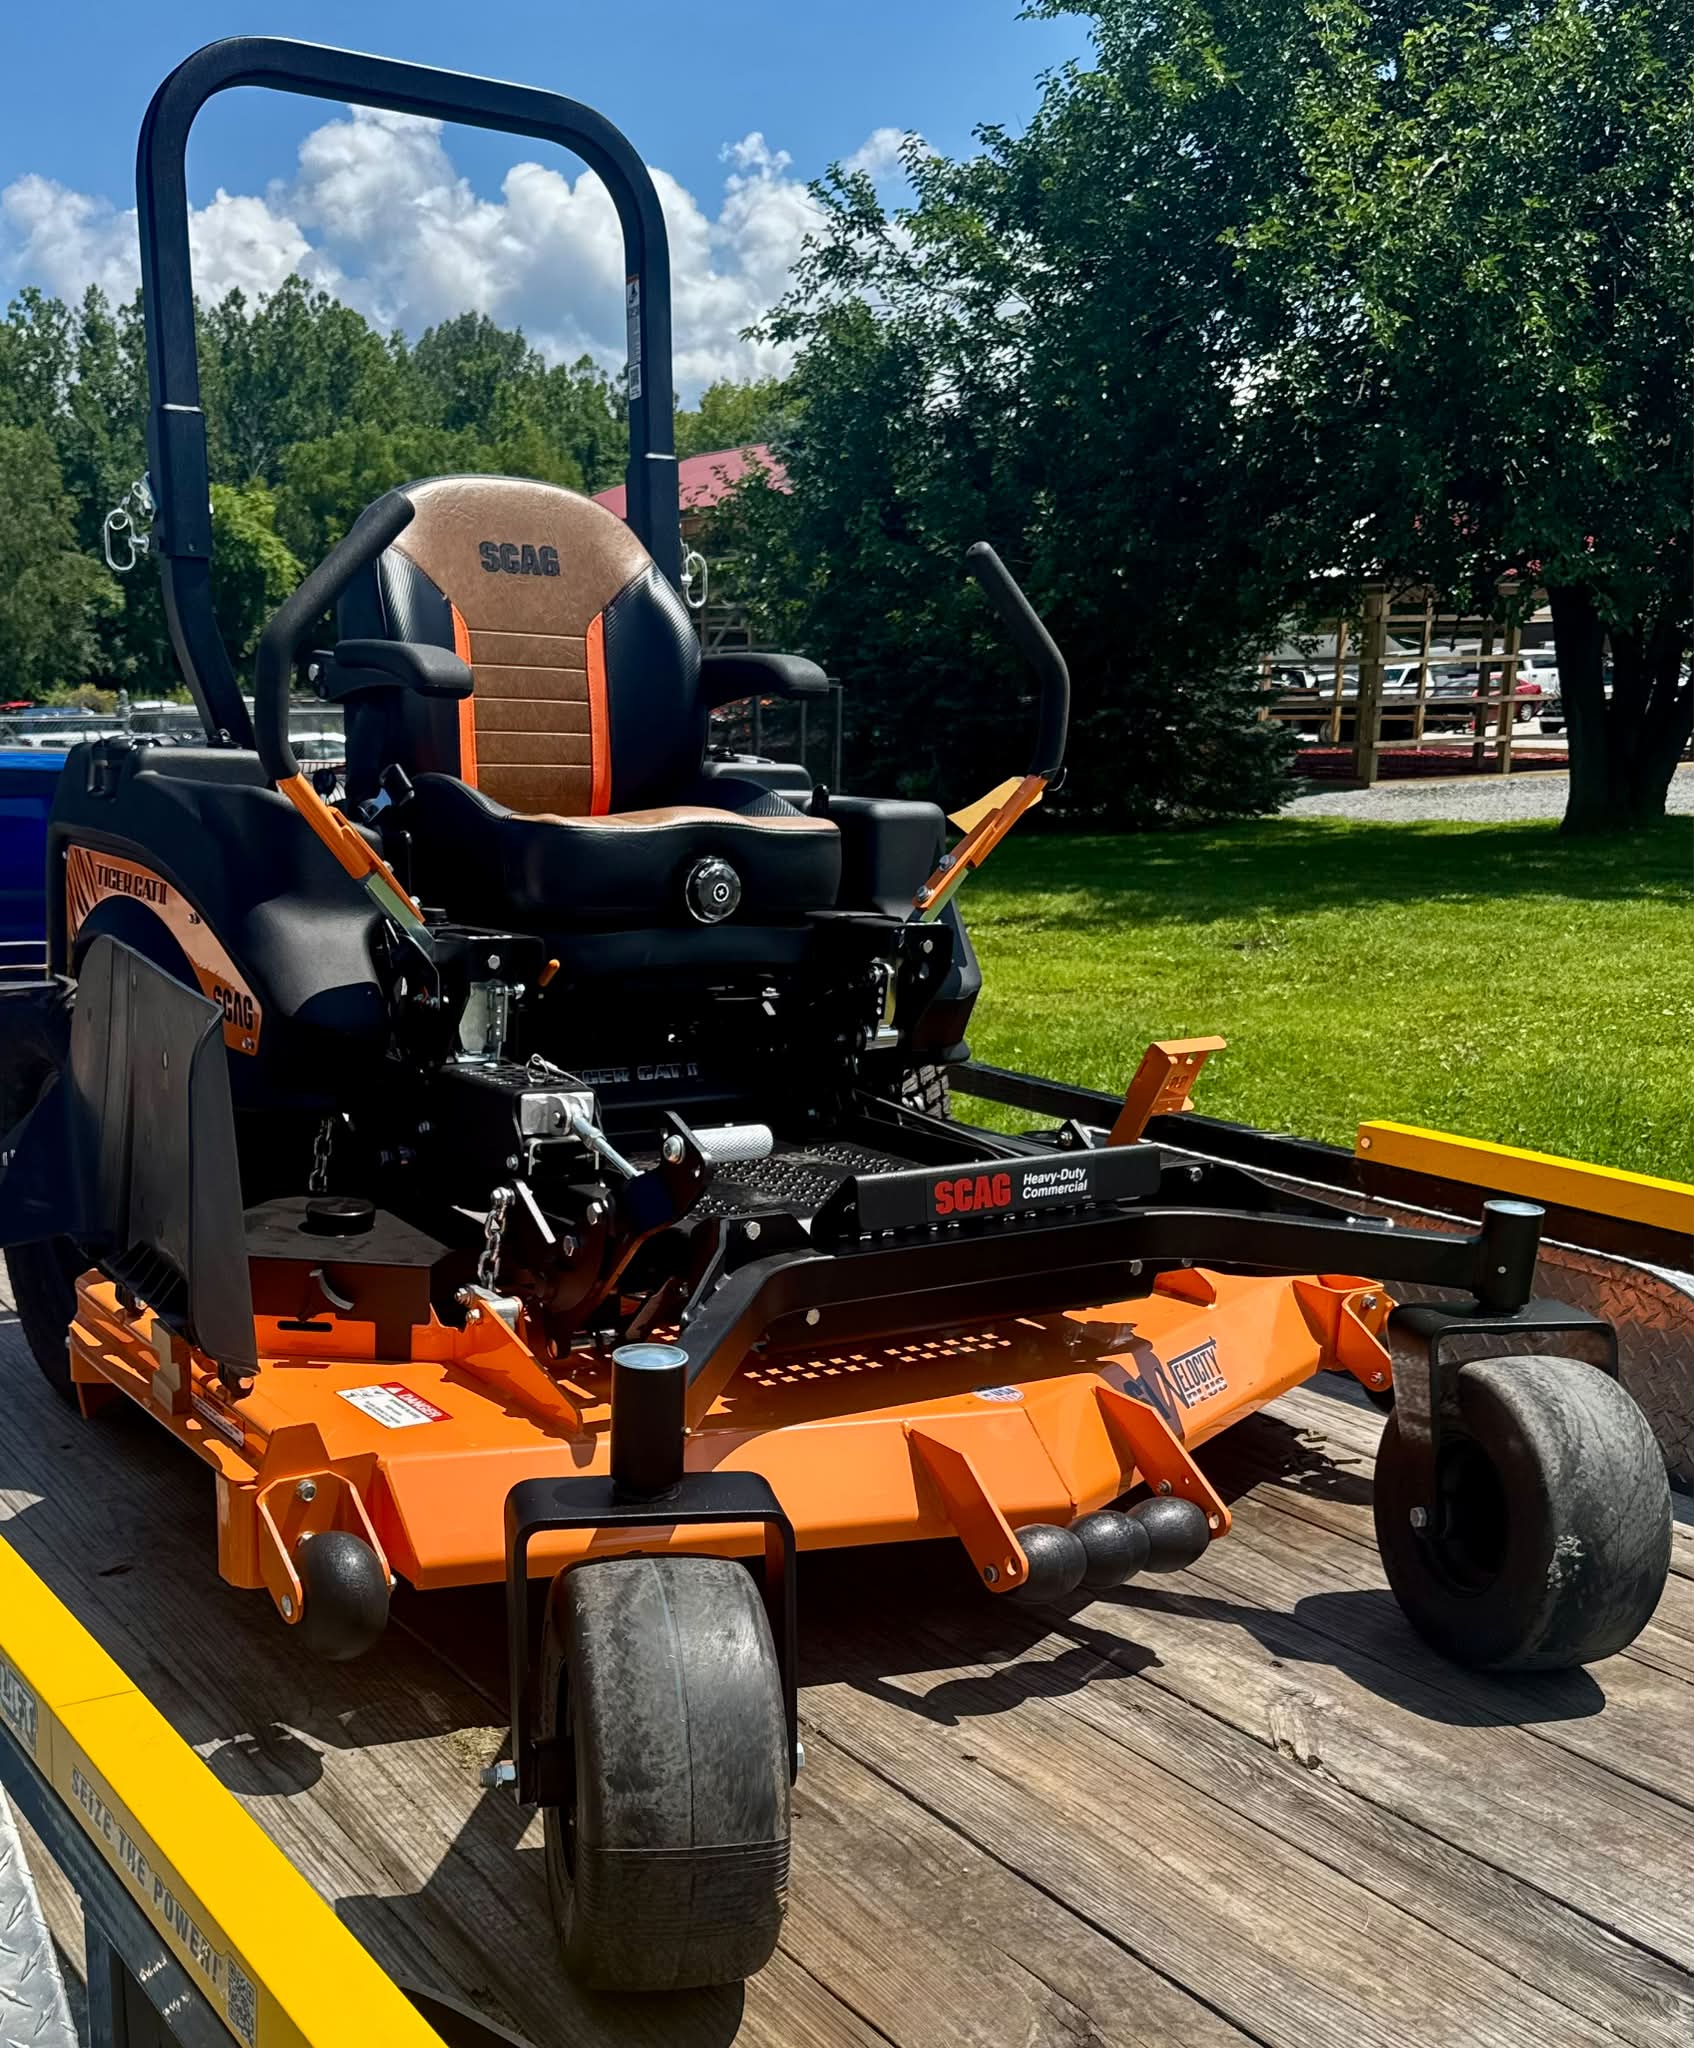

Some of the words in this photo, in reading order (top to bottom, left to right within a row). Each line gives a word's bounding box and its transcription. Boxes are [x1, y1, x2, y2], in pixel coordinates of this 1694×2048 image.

[479, 541, 560, 576] SCAG
[96, 864, 132, 894] TIGER
[134, 875, 159, 902] CAT
[213, 984, 254, 1030] SCAG
[935, 1173, 1011, 1214] SCAG
[1022, 1179, 1088, 1199] Commercial
[1023, 1168, 1086, 1185] Heavy-Duty
[398, 1393, 443, 1418] DANGER
[1186, 1376, 1228, 1407] PLUS
[71, 1767, 114, 1842] SEIZE
[117, 1829, 146, 1887] THE
[153, 1876, 220, 1984] POWER!
